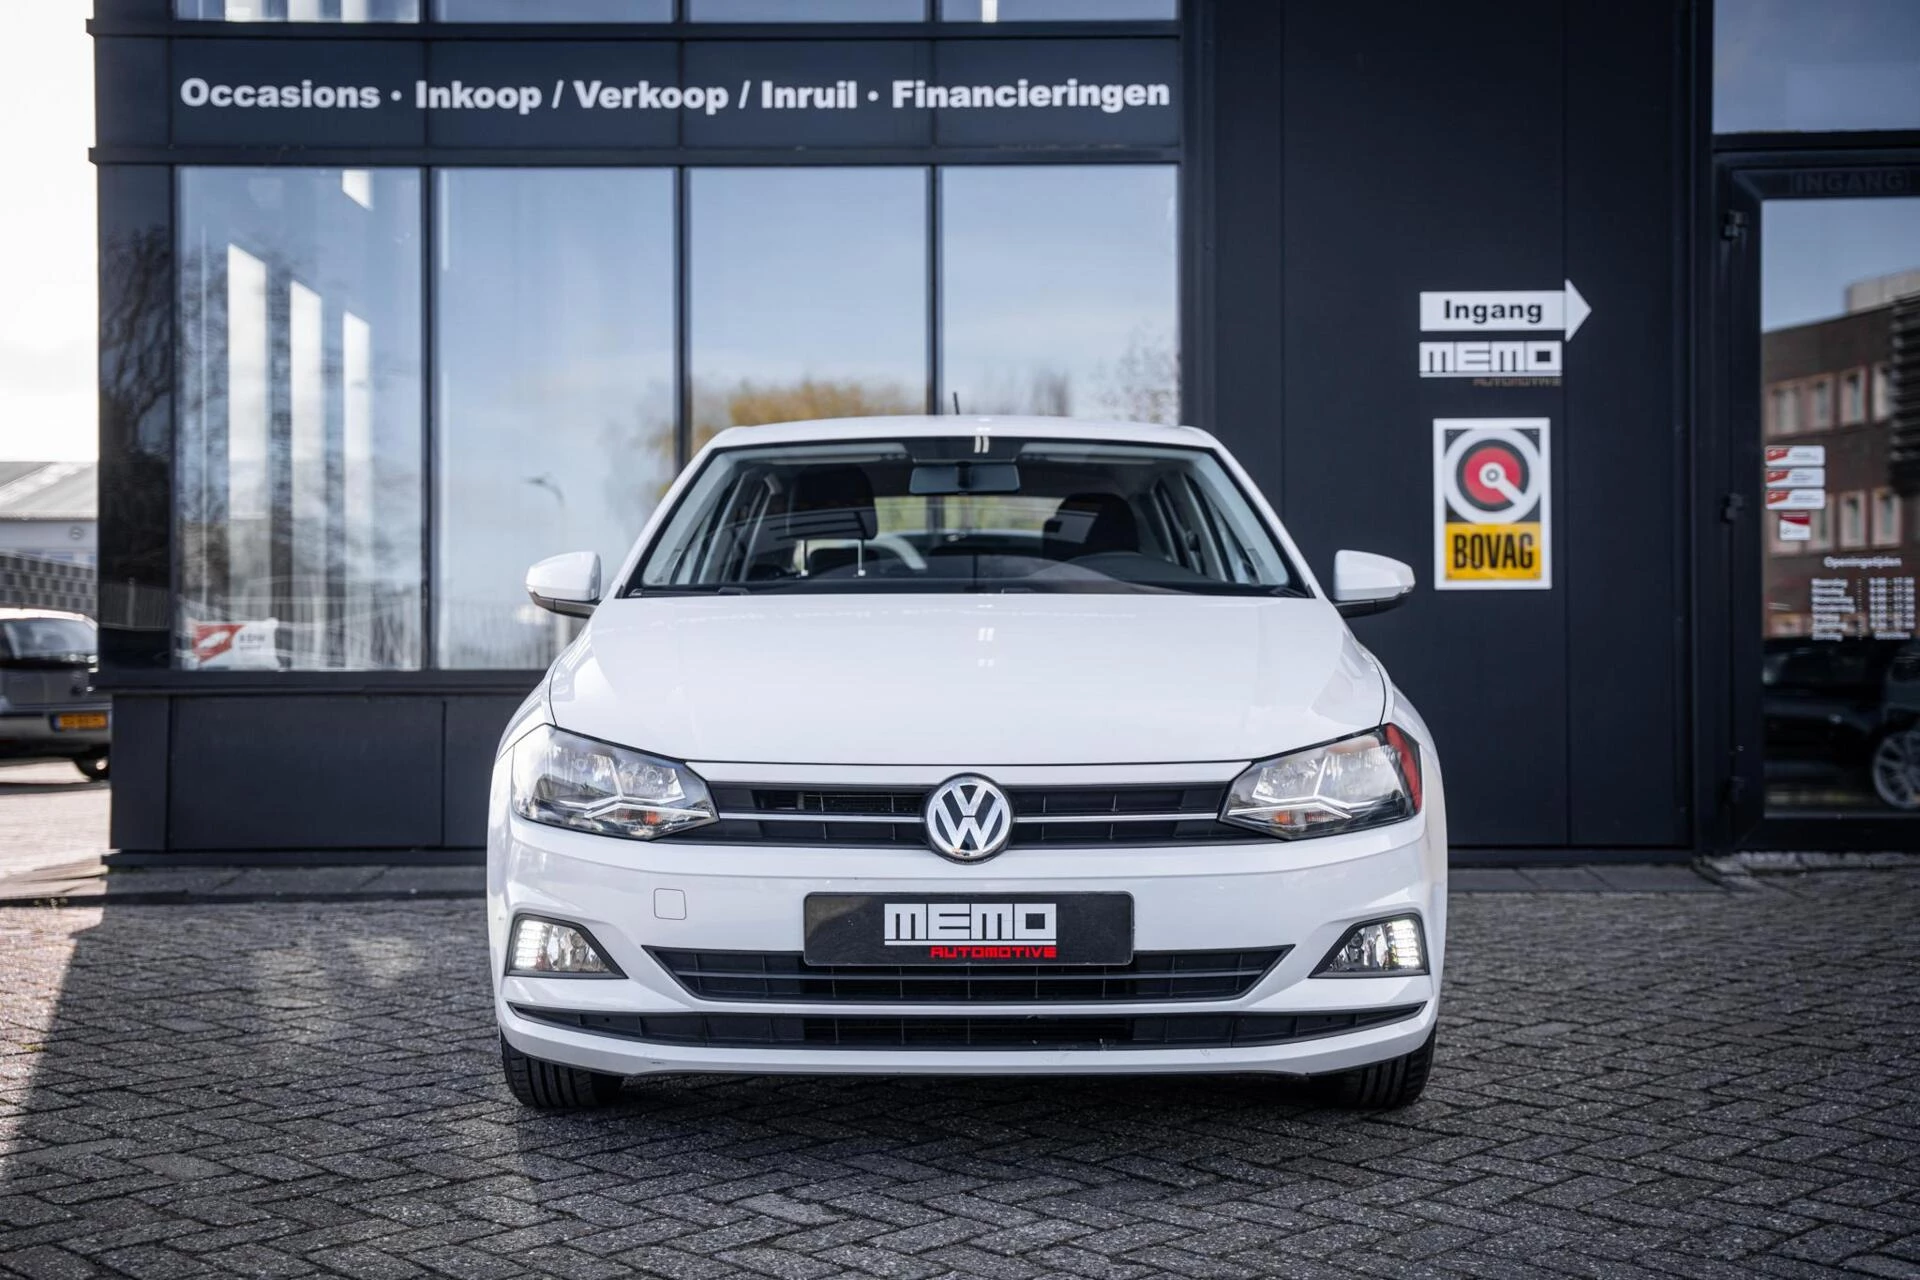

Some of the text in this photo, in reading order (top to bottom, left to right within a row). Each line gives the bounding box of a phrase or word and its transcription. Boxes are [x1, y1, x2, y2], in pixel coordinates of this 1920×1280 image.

[179, 78, 381, 109] Occasions
[416, 80, 542, 115] Inkoop
[573, 80, 729, 115] Verkoop
[761, 80, 858, 109] Inruil
[892, 78, 1170, 114] Financieringen
[1795, 169, 1905, 193] INGANG
[1443, 299, 1543, 324] Ingang
[1419, 341, 1562, 374] MEMO
[1453, 533, 1535, 570] BOVAG
[884, 903, 1057, 941] MEMO
[930, 946, 1057, 959] AUTOMOTIVE
